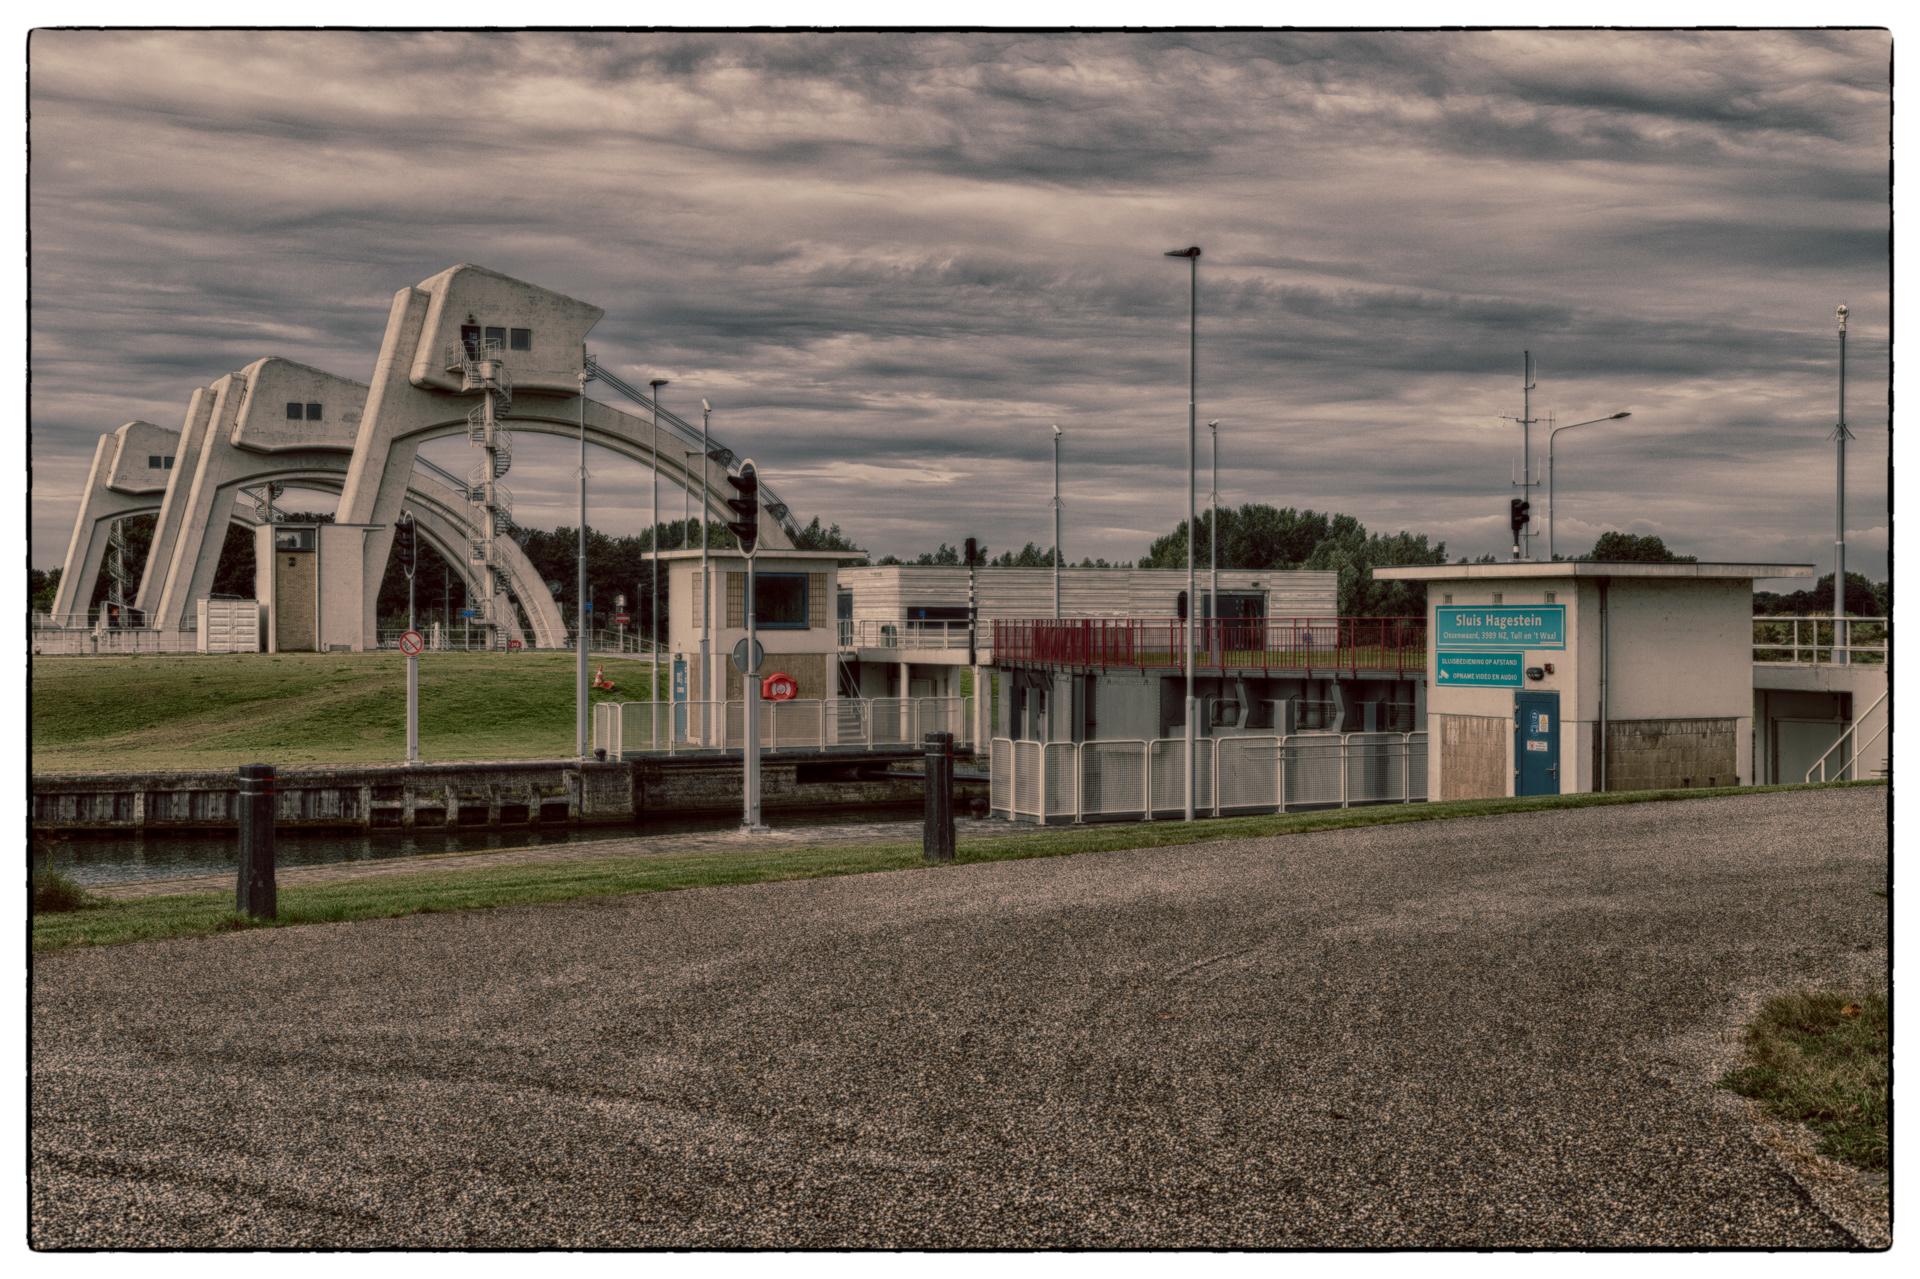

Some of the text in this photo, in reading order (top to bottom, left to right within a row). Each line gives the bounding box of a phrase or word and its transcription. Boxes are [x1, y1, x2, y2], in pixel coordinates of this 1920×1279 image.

[1456, 614, 1542, 629] Sluis Hagestein
[1443, 631, 1479, 640] Ossenwaard,
[1482, 631, 1496, 639] 3989
[1498, 632, 1509, 640] NZ,
[1540, 632, 1557, 640] Waal
